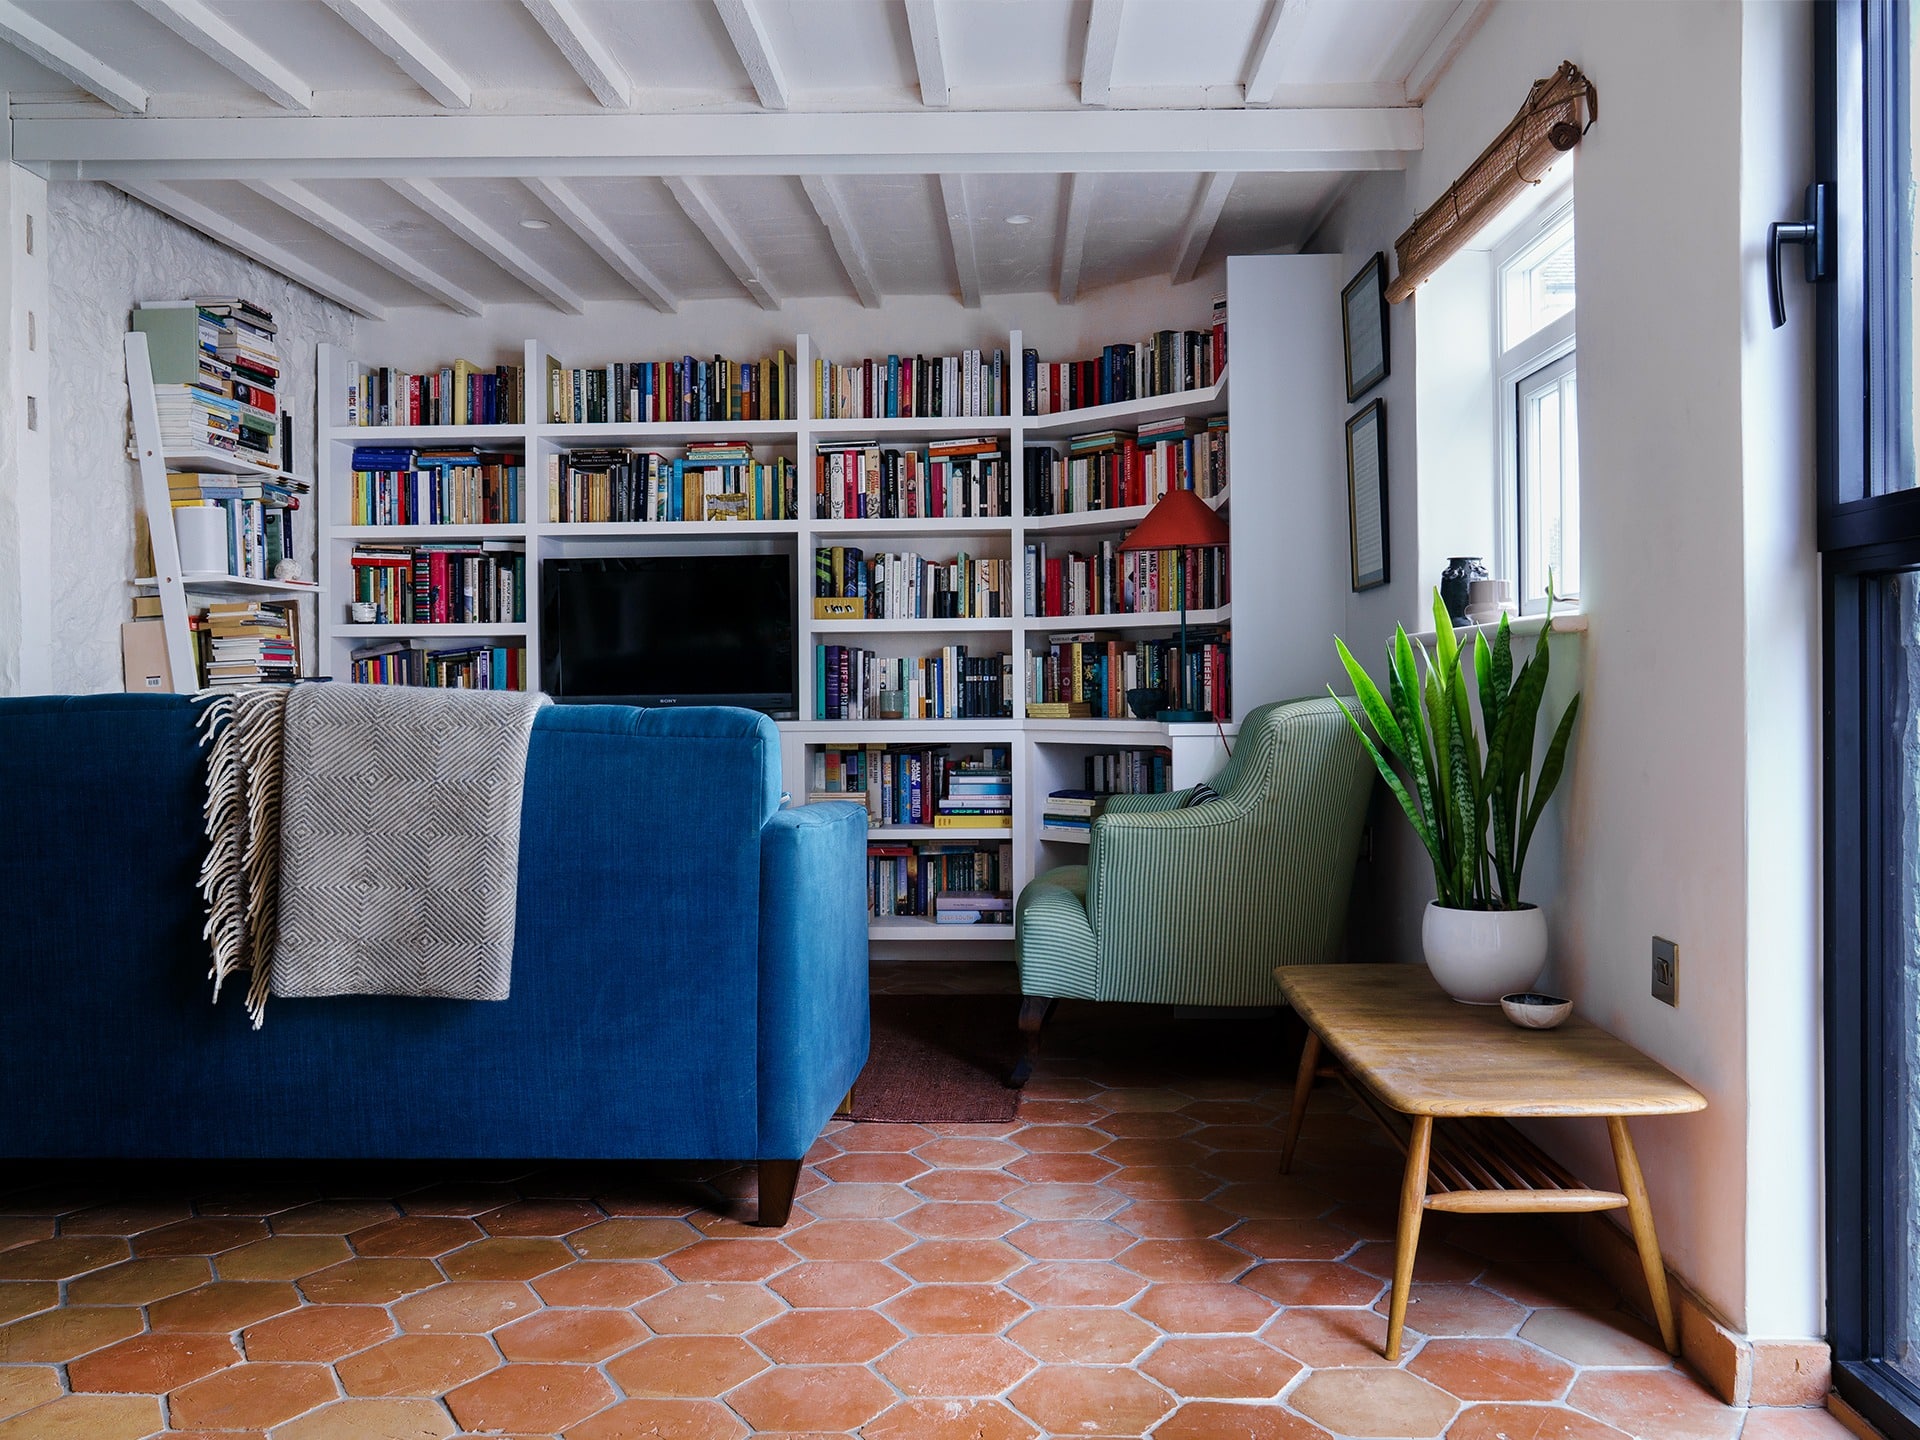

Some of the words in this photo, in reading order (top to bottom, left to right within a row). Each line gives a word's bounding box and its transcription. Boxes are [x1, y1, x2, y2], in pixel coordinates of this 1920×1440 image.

[349, 387, 357, 408] BRICK
[840, 662, 848, 680] LIFE
[911, 789, 921, 818] INTERMEZZO
